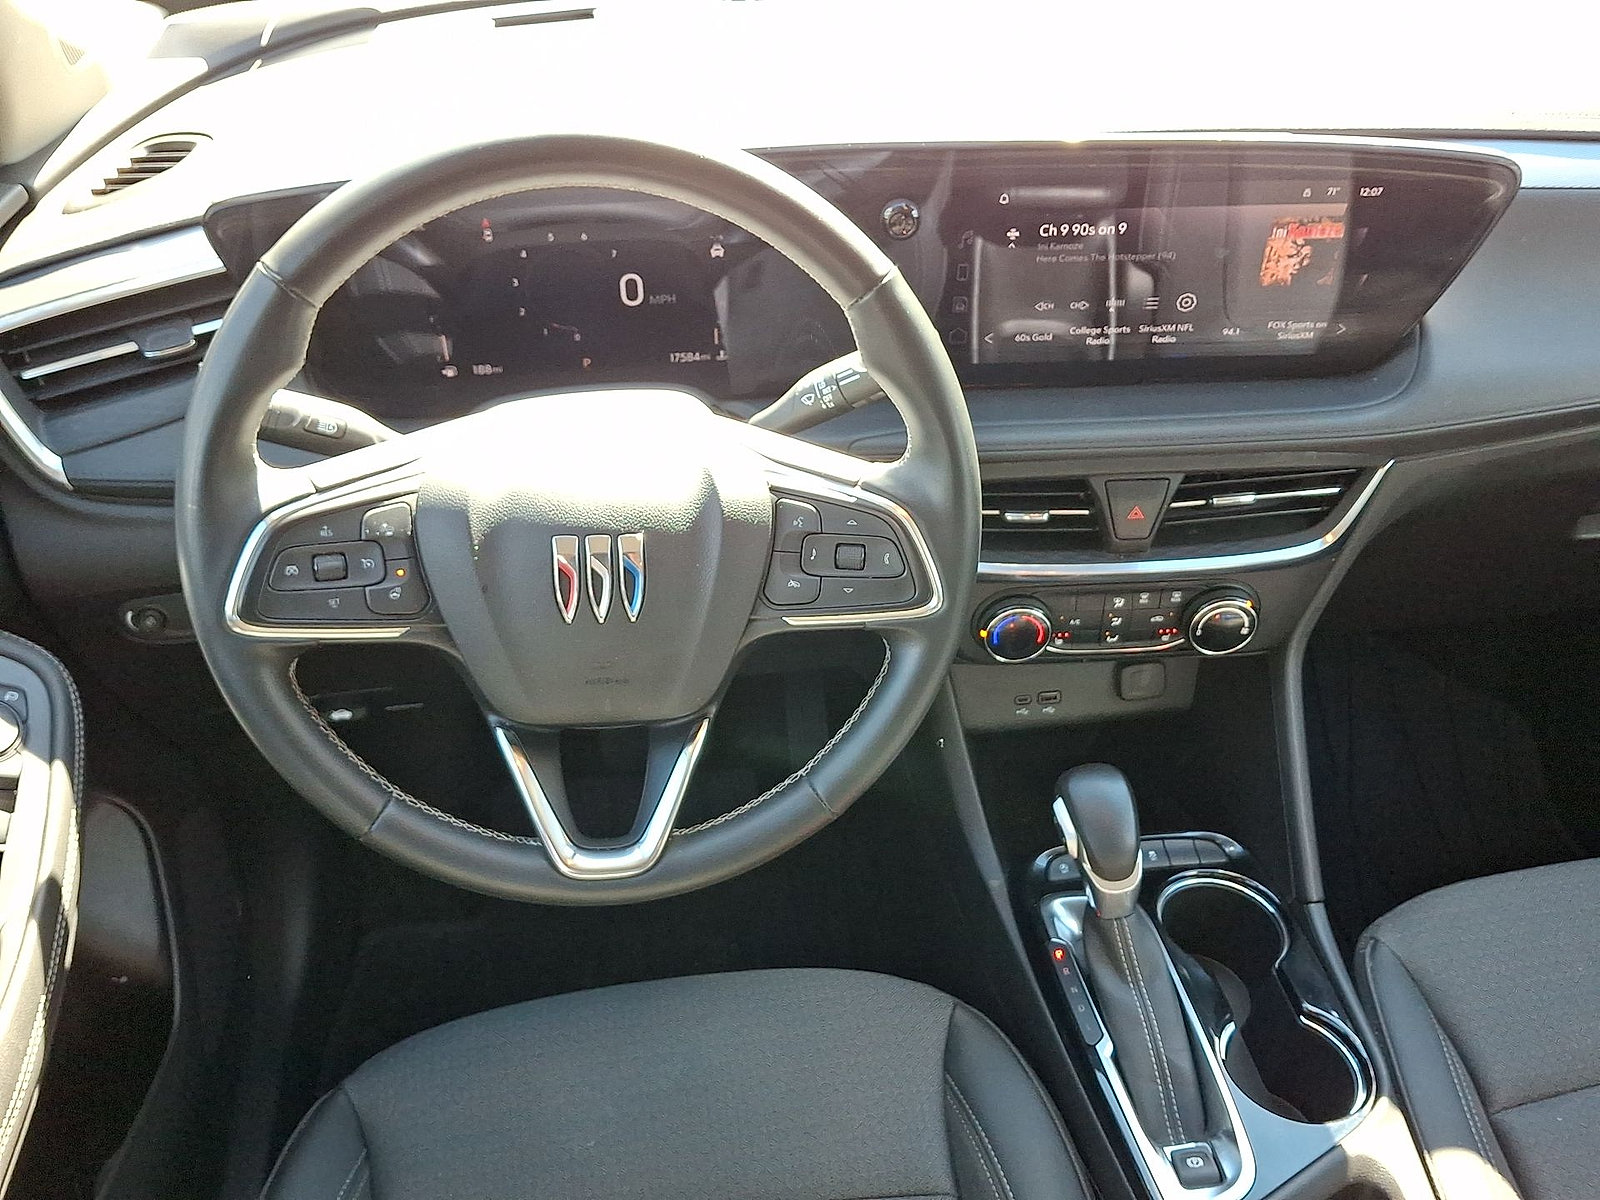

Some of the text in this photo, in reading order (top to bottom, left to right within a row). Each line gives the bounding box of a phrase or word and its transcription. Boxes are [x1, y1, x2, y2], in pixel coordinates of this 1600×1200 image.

[1360, 186, 1384, 197] 12:07
[1039, 221, 1128, 237] Ch 9 90s on 9
[1091, 253, 1107, 261] The
[619, 272, 677, 307] 0 MPH
[1069, 325, 1131, 336] College Sports
[1138, 323, 1195, 334] SiriusXM NFL
[1266, 321, 1286, 330] FOX
[1014, 332, 1053, 343] 60s Gold
[1086, 336, 1110, 346] Radio
[1152, 334, 1177, 344] Radio
[582, 357, 592, 369] P
